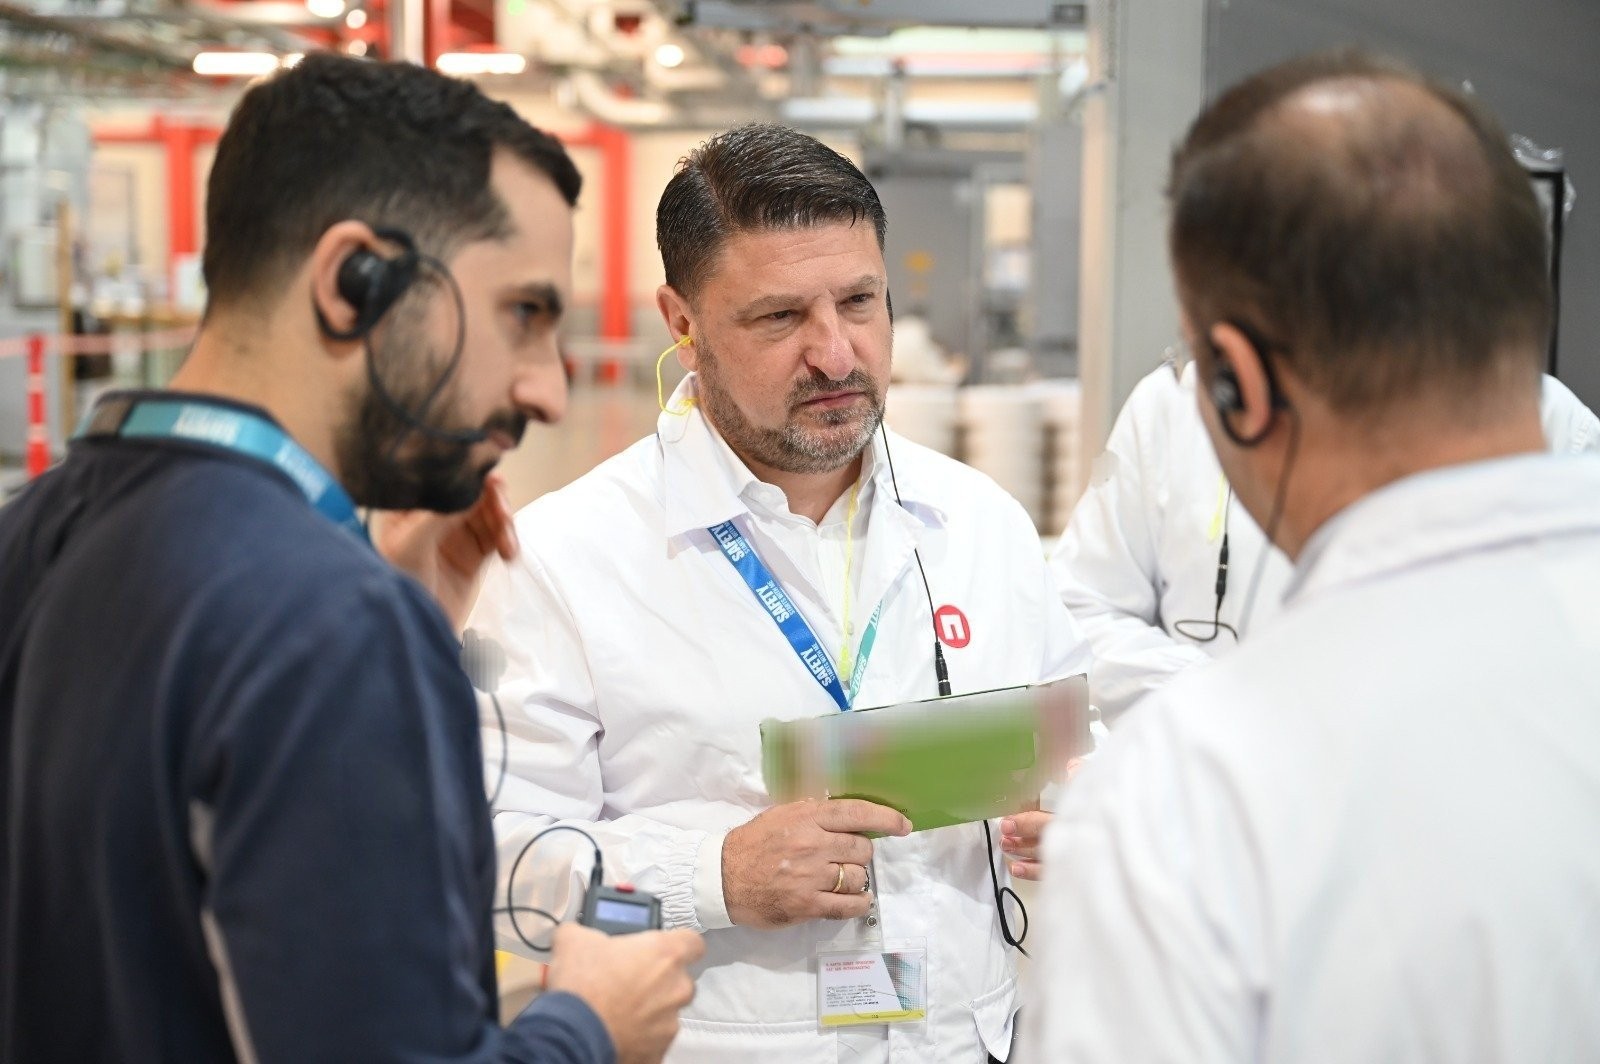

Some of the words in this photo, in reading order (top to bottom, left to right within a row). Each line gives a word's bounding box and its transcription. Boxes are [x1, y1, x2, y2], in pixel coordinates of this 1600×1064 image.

[710, 524, 745, 562] SAFETY
[771, 586, 784, 600] WITH
[755, 584, 790, 624] SAFETY
[779, 597, 795, 615] STARTS
[815, 649, 827, 663] WITH
[799, 647, 833, 687] SAFETY
[823, 661, 836, 680] STARTS
